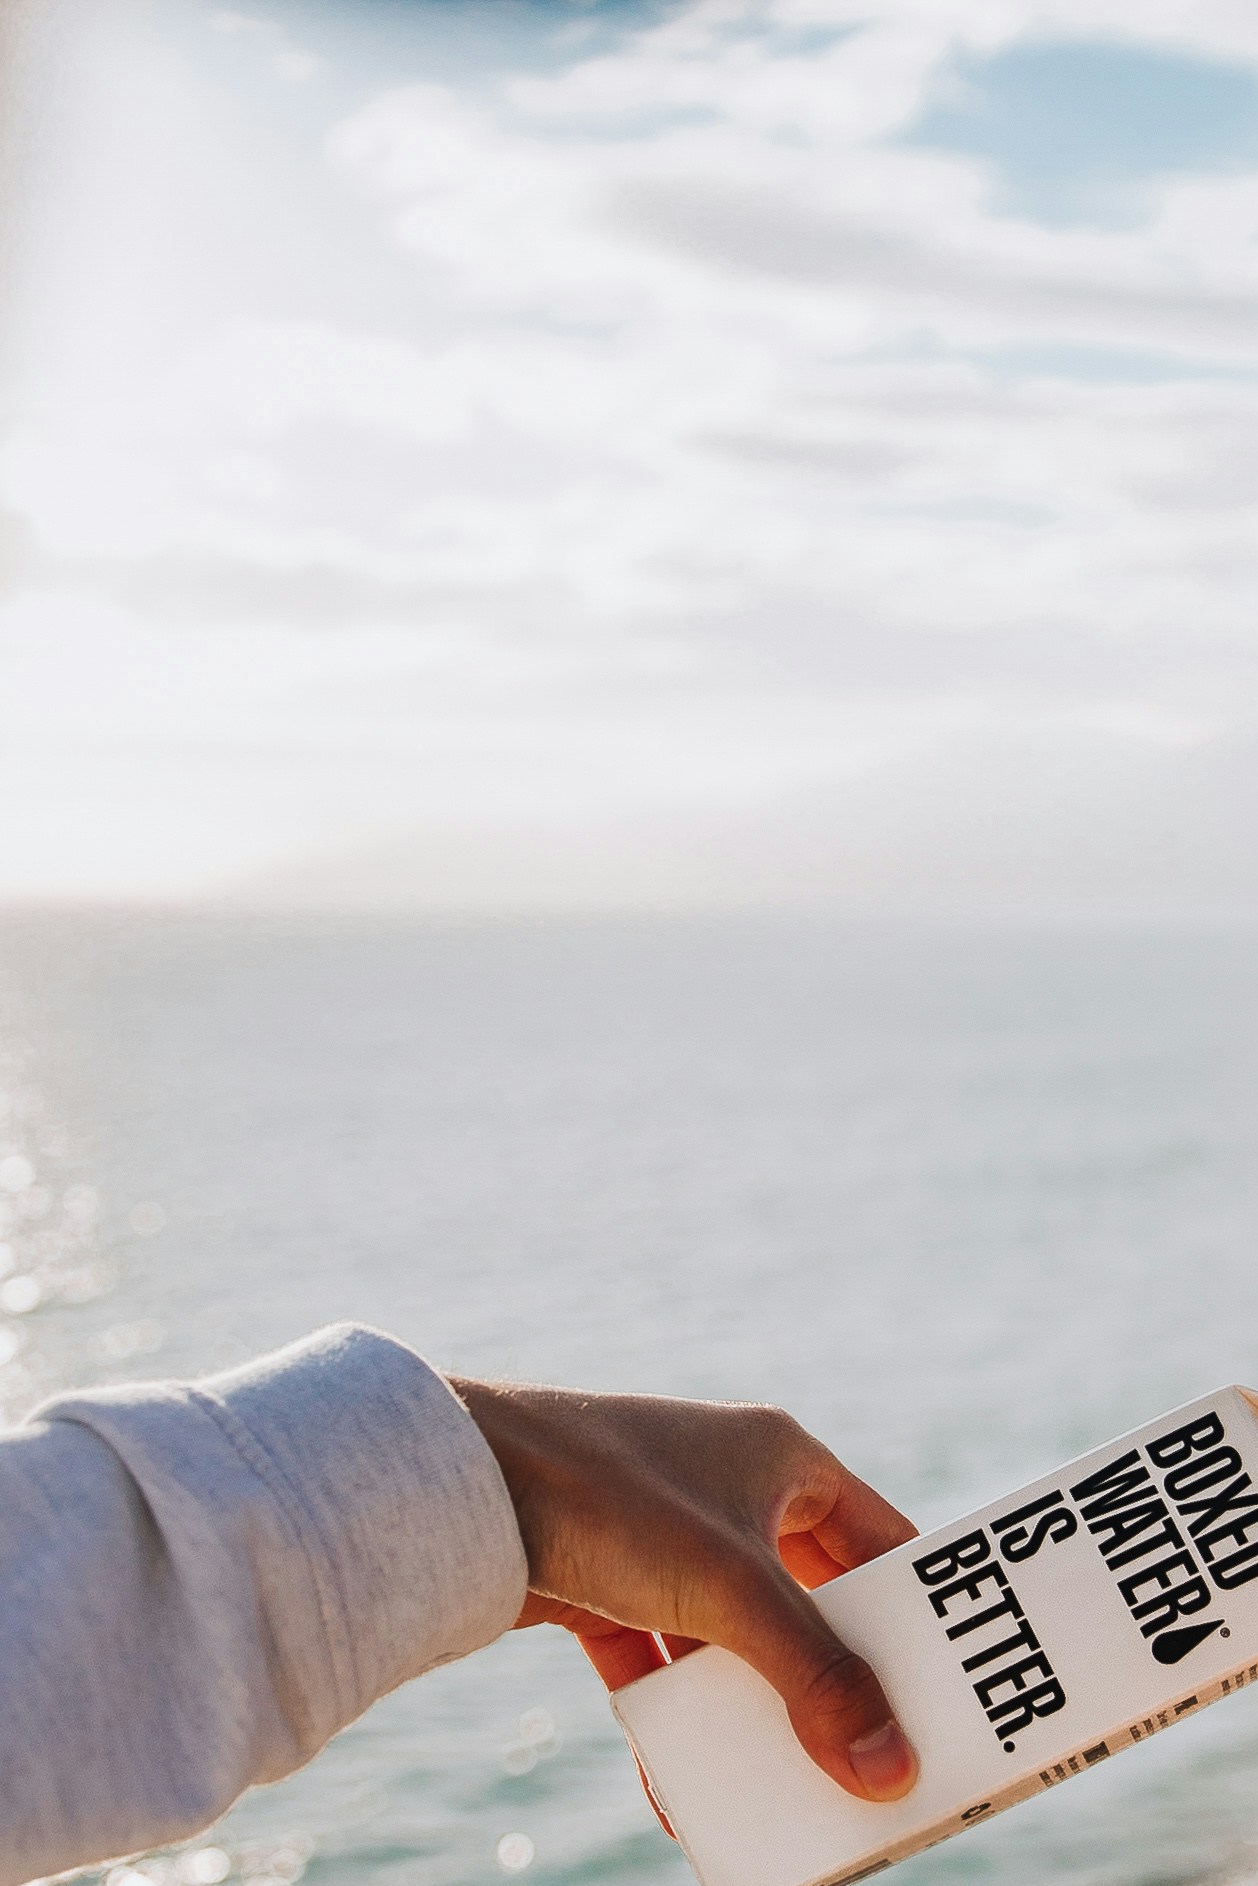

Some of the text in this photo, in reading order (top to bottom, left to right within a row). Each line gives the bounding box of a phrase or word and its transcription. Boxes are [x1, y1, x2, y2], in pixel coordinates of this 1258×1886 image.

[988, 1488, 1078, 1564] IS
[1069, 1448, 1212, 1640] WATER
[910, 1528, 1067, 1754] BETTER.
